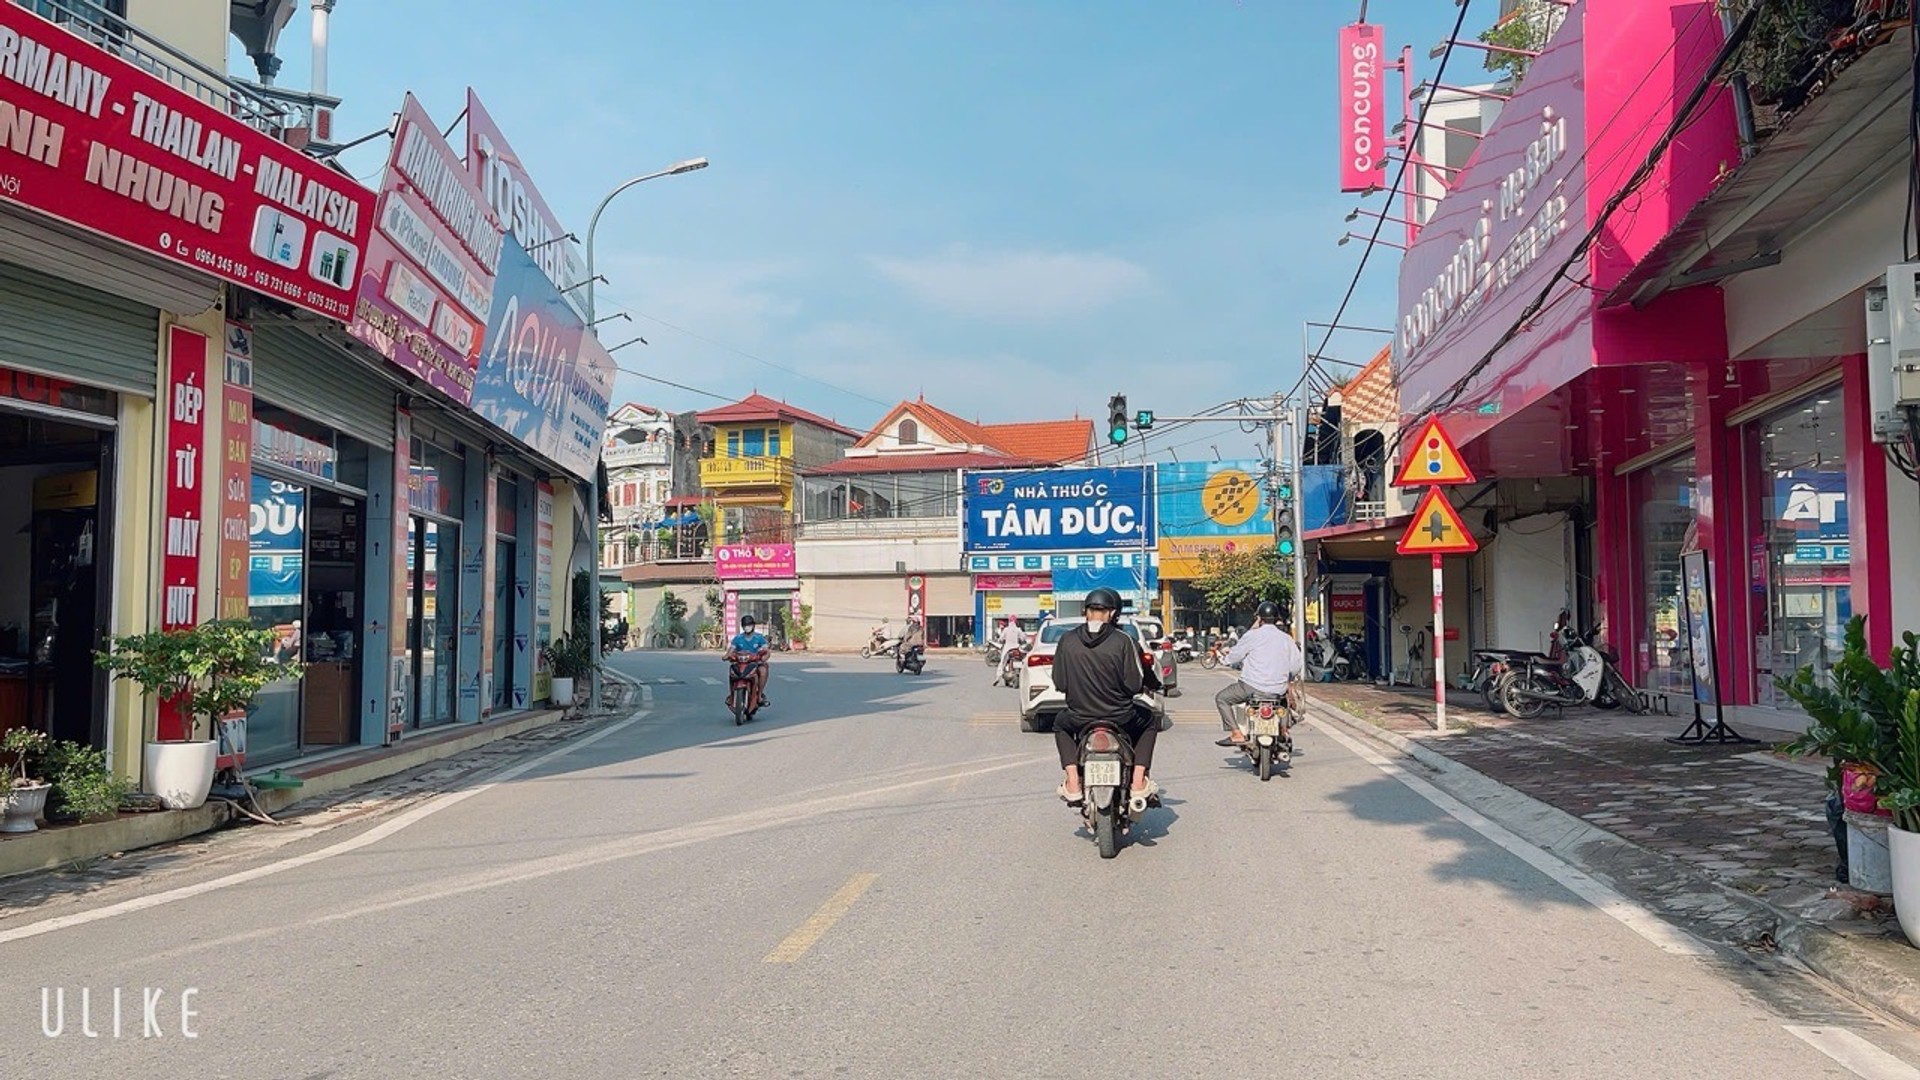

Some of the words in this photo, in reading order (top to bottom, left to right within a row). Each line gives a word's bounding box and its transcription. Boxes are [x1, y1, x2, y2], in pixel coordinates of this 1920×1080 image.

[1352, 42, 1377, 173] concung
[85, 141, 225, 234] NHUNG
[131, 92, 241, 181] THAILAN
[254, 154, 359, 238] MALAYSIA
[478, 134, 566, 293] TOSHIBA
[174, 371, 202, 425] BẾP
[228, 400, 247, 425] MUA
[175, 443, 197, 489] TỪ
[228, 434, 246, 463] BÁN
[1014, 482, 1047, 499] NHÀ
[1051, 479, 1108, 498] THUỐC
[167, 511, 199, 558] MÁY
[982, 503, 1051, 537] TÂM
[1060, 500, 1135, 536] ĐỨC
[229, 554, 242, 580] ÉP
[166, 577, 195, 626] HÚT
